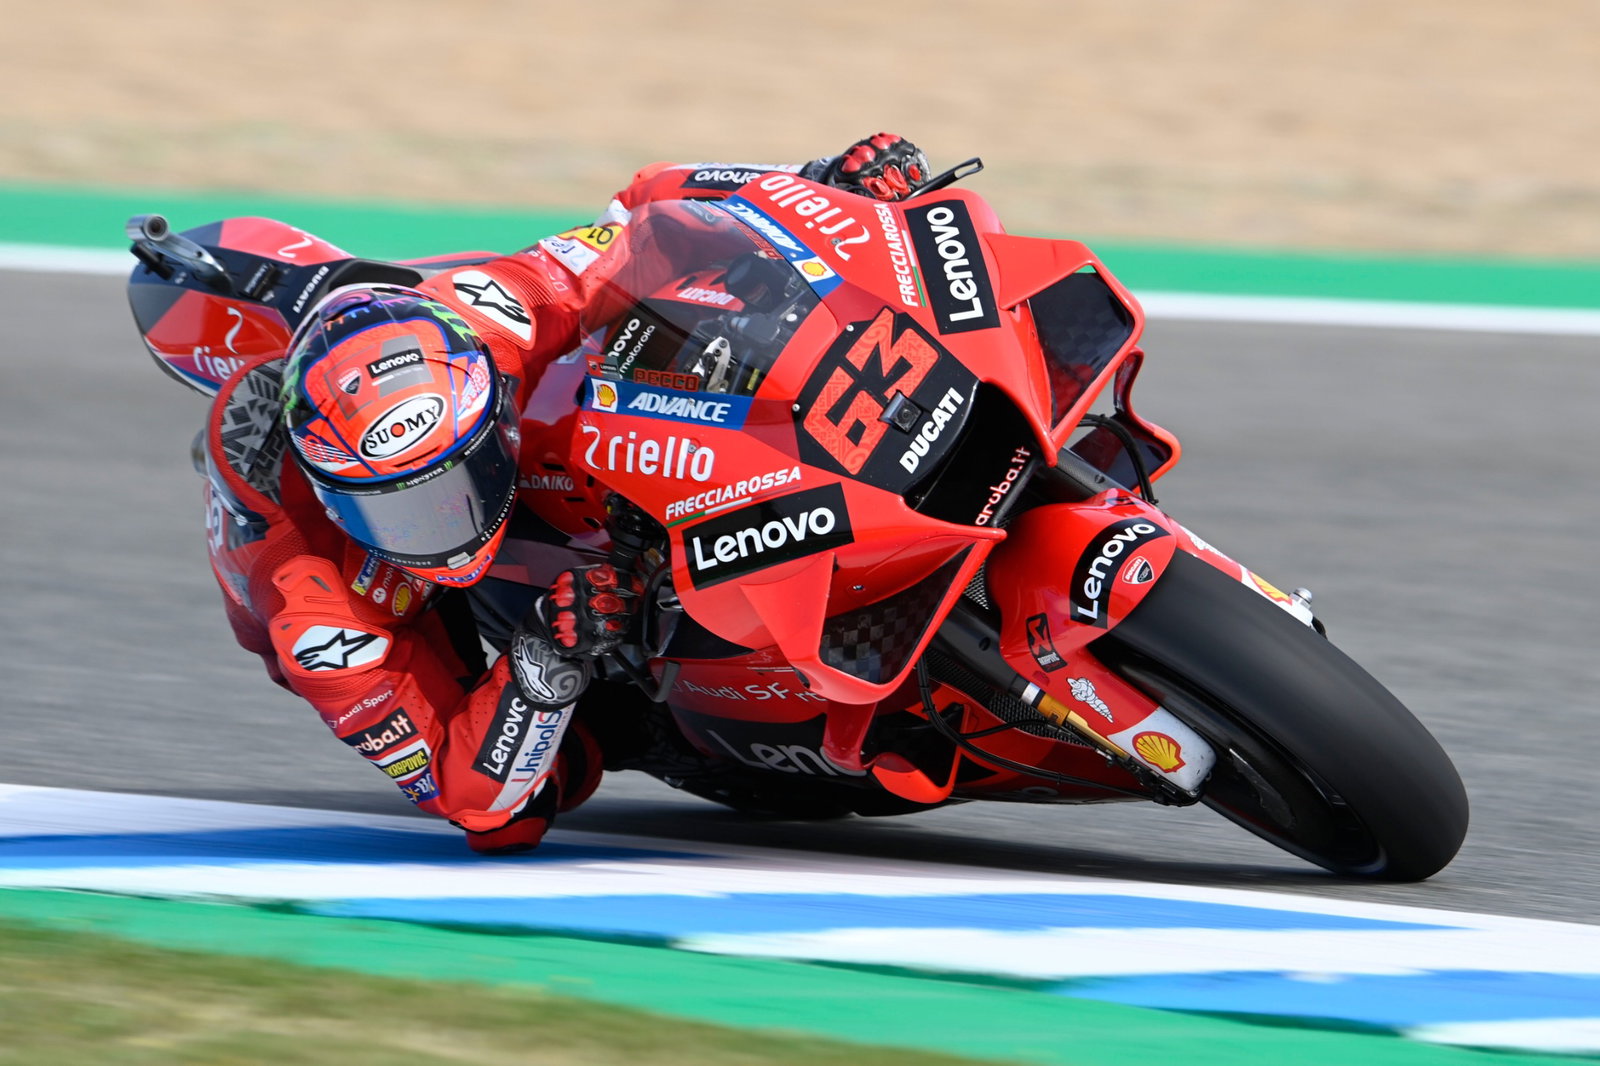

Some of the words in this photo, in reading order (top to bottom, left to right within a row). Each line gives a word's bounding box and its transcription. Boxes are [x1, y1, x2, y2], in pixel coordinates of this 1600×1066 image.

[694, 170, 760, 184] enovo
[760, 174, 856, 235] riello
[873, 203, 919, 307] FRECCIAROSSA
[926, 206, 984, 322] Lenovo
[293, 265, 330, 314] DUCATI
[371, 353, 420, 374] Lenovo
[619, 325, 656, 374] motorola
[633, 368, 699, 393] PECCO
[803, 307, 941, 475] 63
[365, 405, 440, 450] SUOMY
[628, 391, 731, 423] ADVANCE
[899, 387, 965, 474] DUCATI
[607, 431, 715, 482] riello
[665, 466, 802, 521] FRECCIAROSSA
[975, 446, 1031, 527] aruba.it
[692, 507, 836, 571] Lenovo
[1077, 522, 1156, 620] Lenovo
[339, 703, 363, 725] Audi
[363, 690, 394, 708] Sport
[682, 679, 747, 701] Audi
[353, 714, 411, 753] ruba.it
[511, 710, 563, 783] UnipolS
